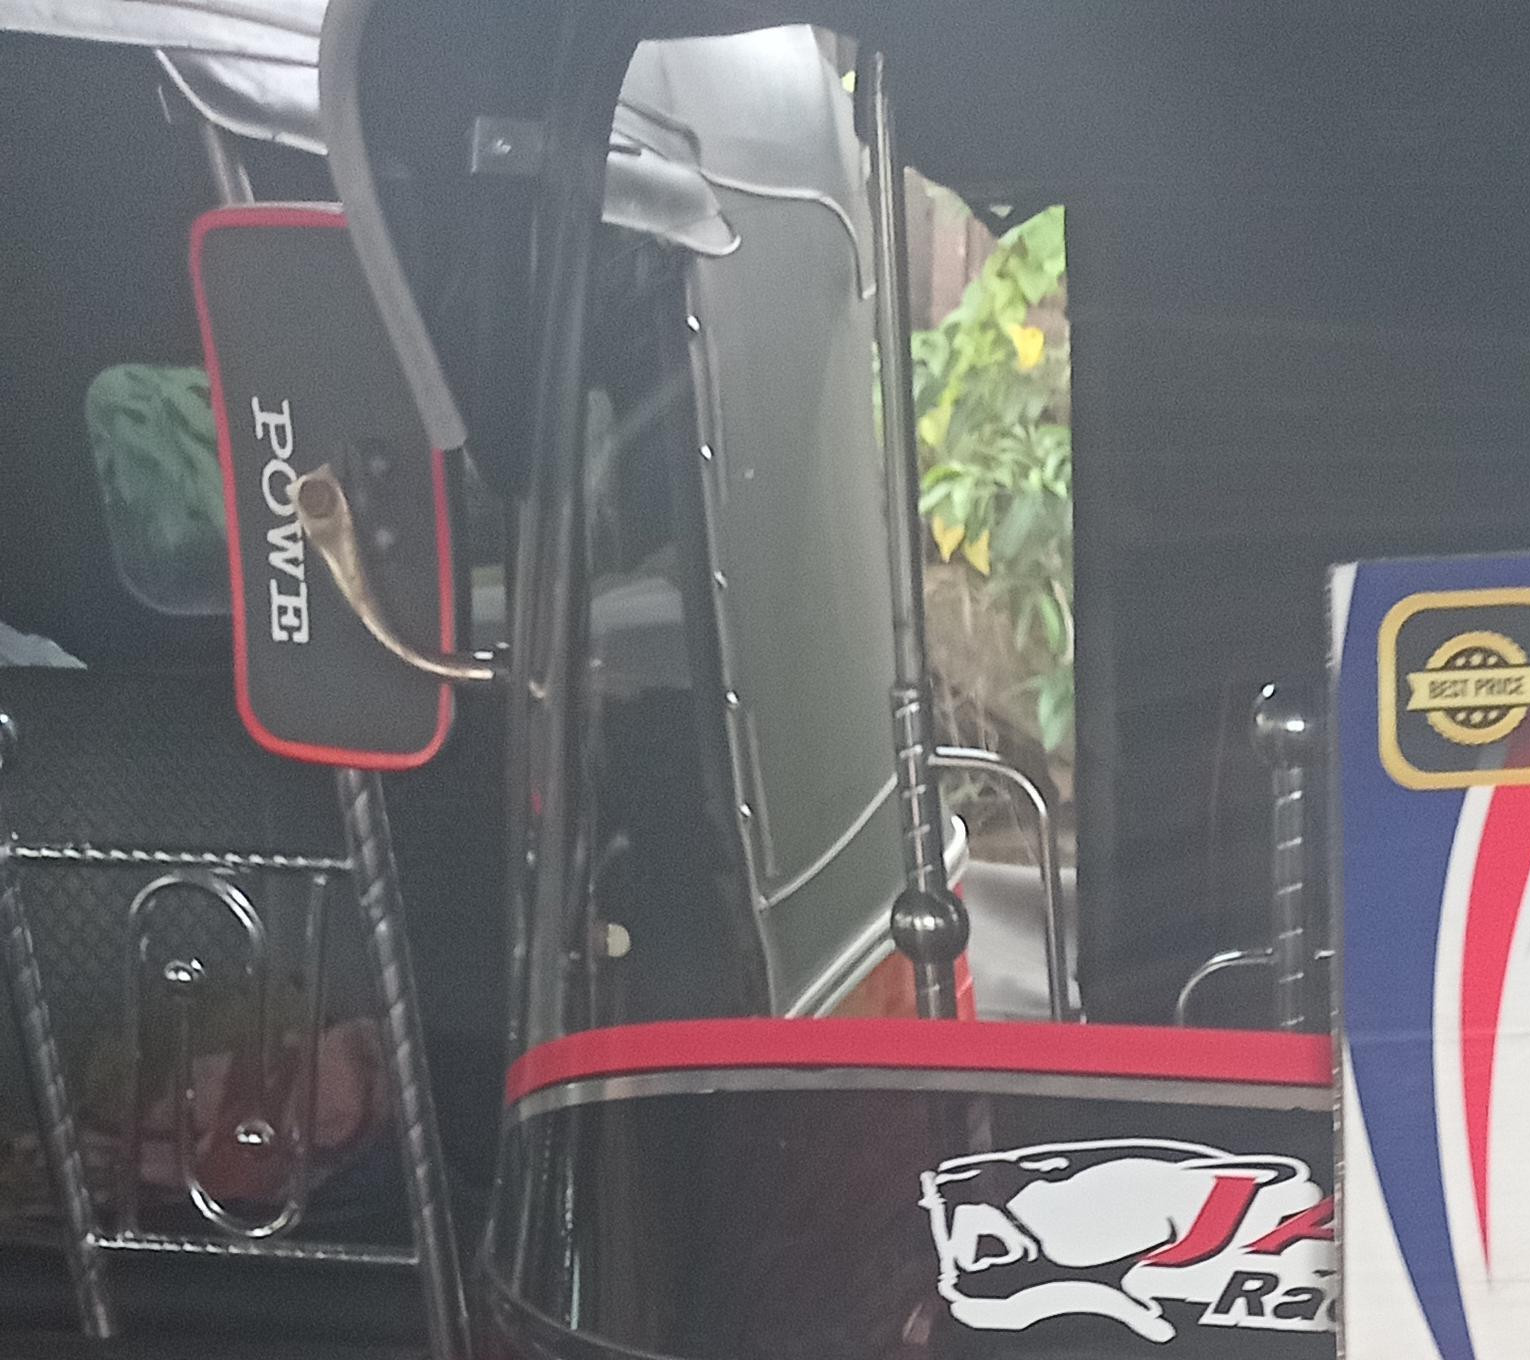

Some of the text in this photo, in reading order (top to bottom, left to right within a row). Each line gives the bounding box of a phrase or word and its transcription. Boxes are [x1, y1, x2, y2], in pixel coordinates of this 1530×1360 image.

[251, 396, 310, 644] POWE
[1429, 676, 1525, 699] BEST PRICE
[1212, 1271, 1336, 1323] Ra
